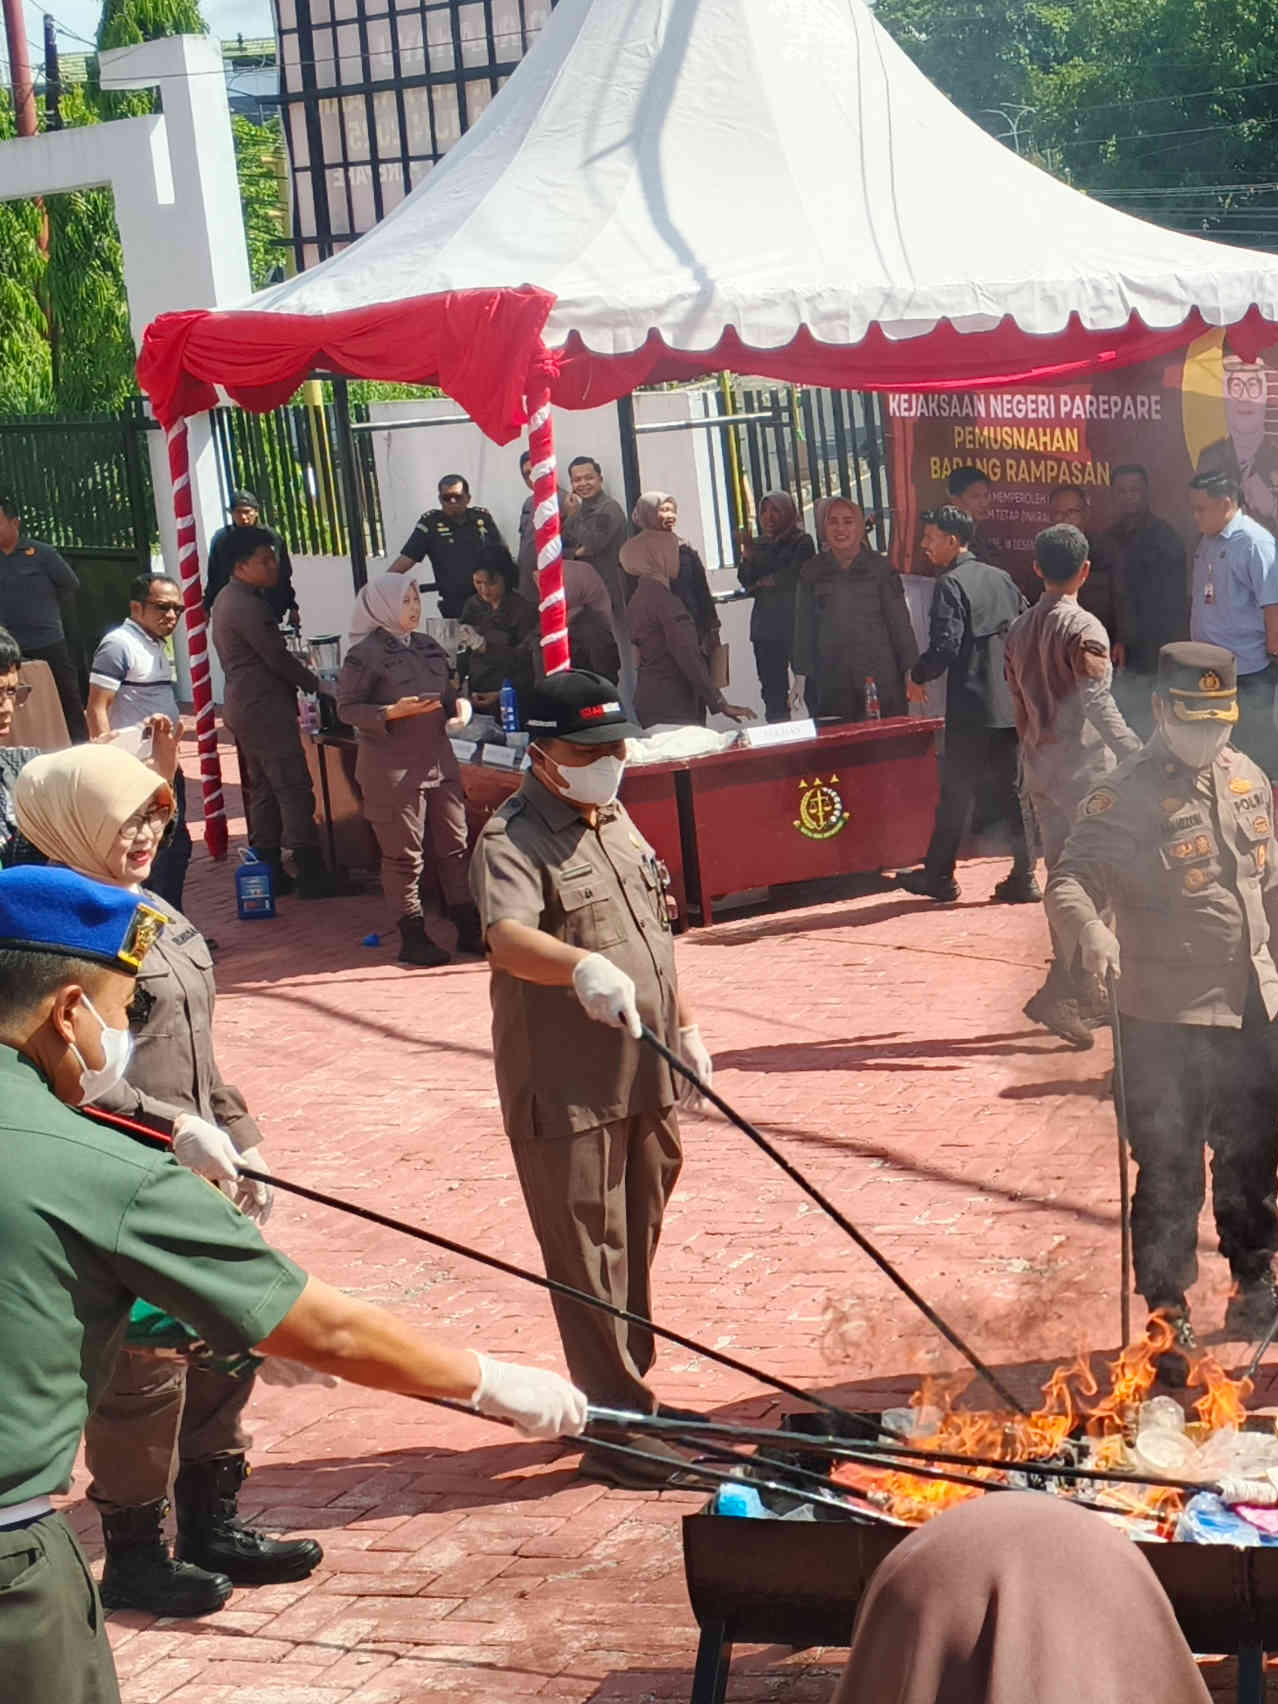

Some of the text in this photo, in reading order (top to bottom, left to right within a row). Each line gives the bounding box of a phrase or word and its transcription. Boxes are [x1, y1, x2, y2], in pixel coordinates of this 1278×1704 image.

[889, 392, 1161, 420] KEJAKSAAN NEGERI PAREPARE
[954, 425, 1079, 452] PEMUSNAHAN
[1006, 458, 1110, 486] RAMPASAN
